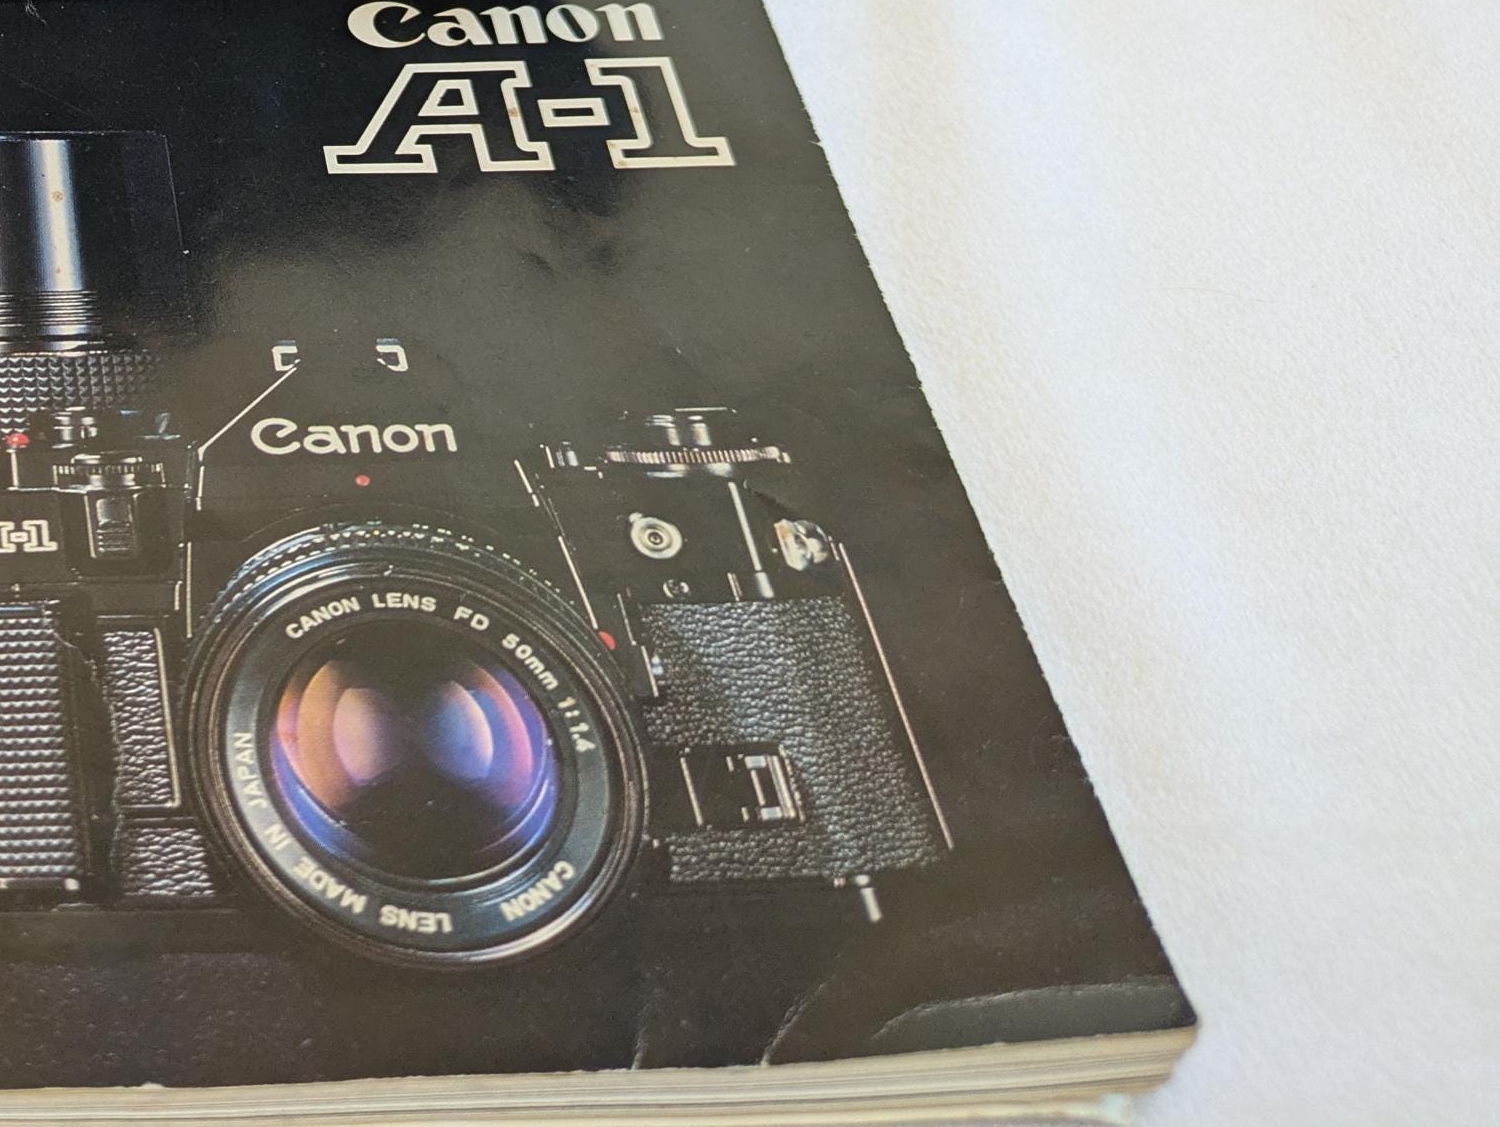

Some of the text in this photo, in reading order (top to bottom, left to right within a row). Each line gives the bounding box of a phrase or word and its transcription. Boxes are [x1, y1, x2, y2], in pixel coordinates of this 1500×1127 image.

[347, 0, 664, 49] Canon
[322, 56, 737, 175] A-1
[250, 417, 458, 455] Canon
[285, 596, 361, 639] CANON
[371, 592, 437, 612] LENS
[453, 605, 490, 631] FD
[501, 633, 559, 691] 50mm
[233, 731, 576, 934] CANON LENS MADE IN JAPAN
